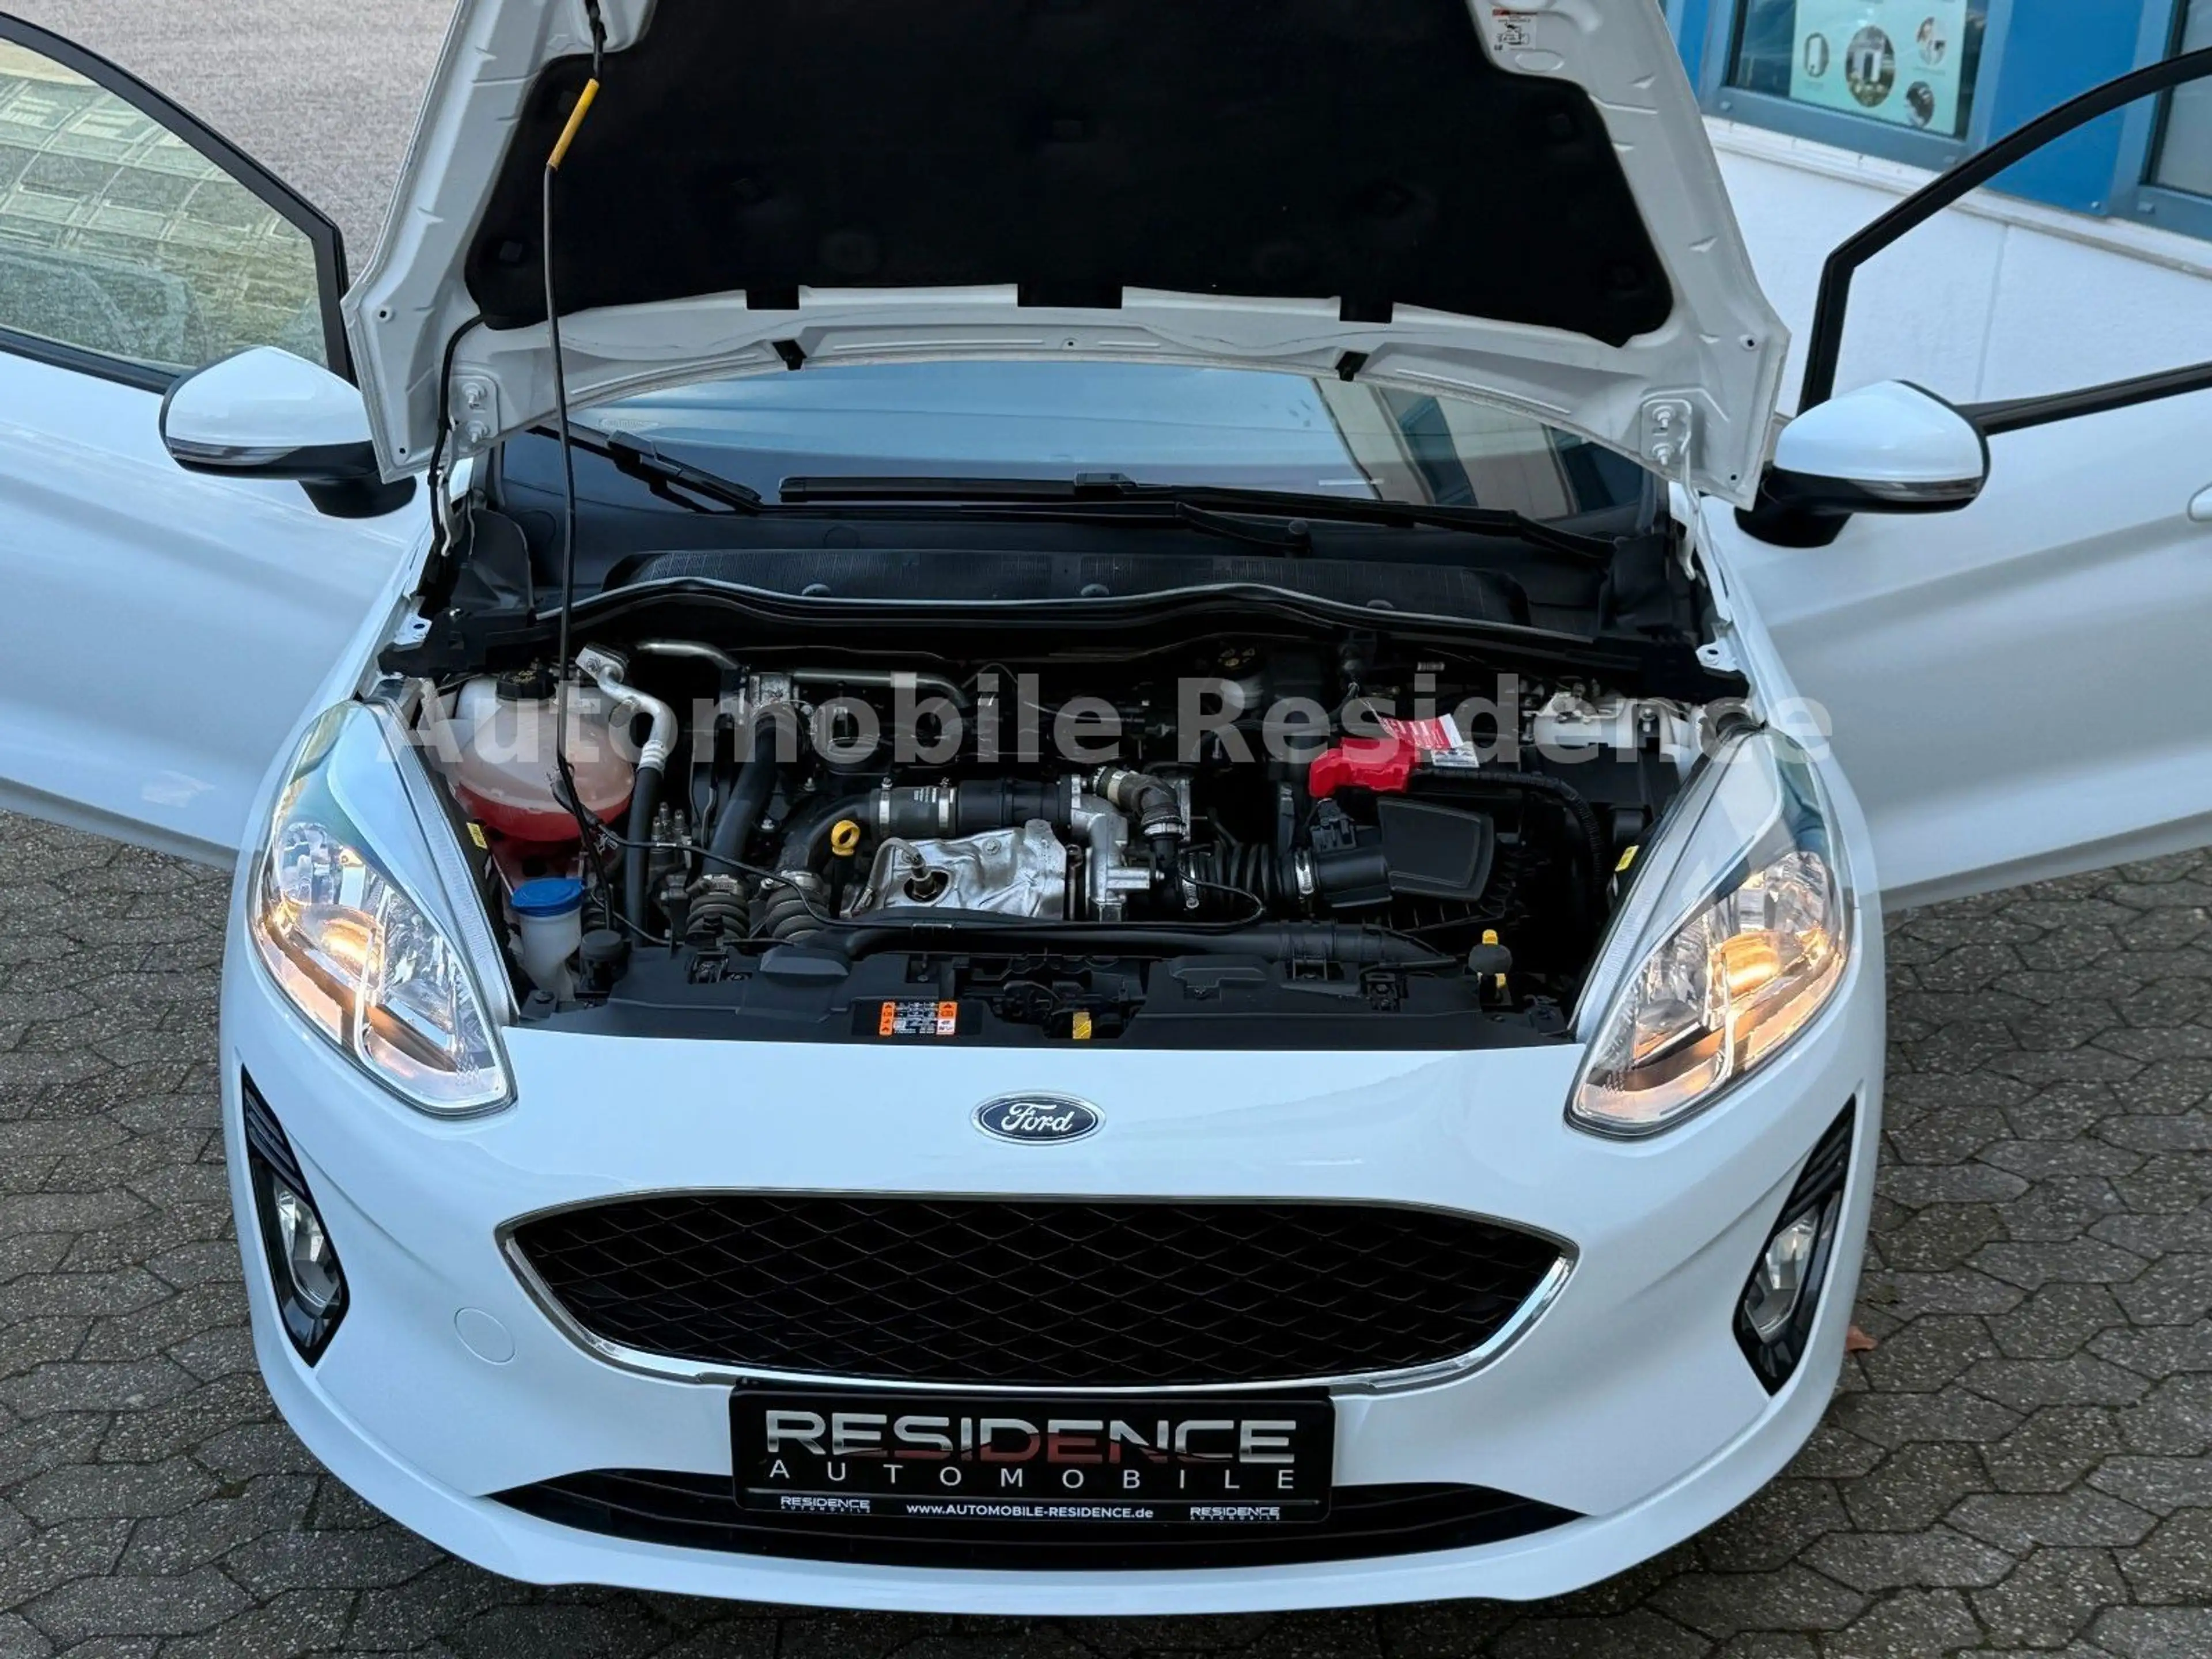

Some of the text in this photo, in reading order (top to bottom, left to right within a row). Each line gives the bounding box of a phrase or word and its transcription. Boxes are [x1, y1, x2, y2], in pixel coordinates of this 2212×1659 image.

[1001, 1103, 1075, 1132] Ford
[766, 1410, 1297, 1464] RESIDENCE
[769, 1459, 1294, 1489] AUTOMOBILE
[781, 1496, 870, 1509] RESIDENCE
[906, 1504, 1154, 1518] www.AUTOMOBILE-RESIDENCE.de
[1190, 1506, 1280, 1516] RESIDENCE
